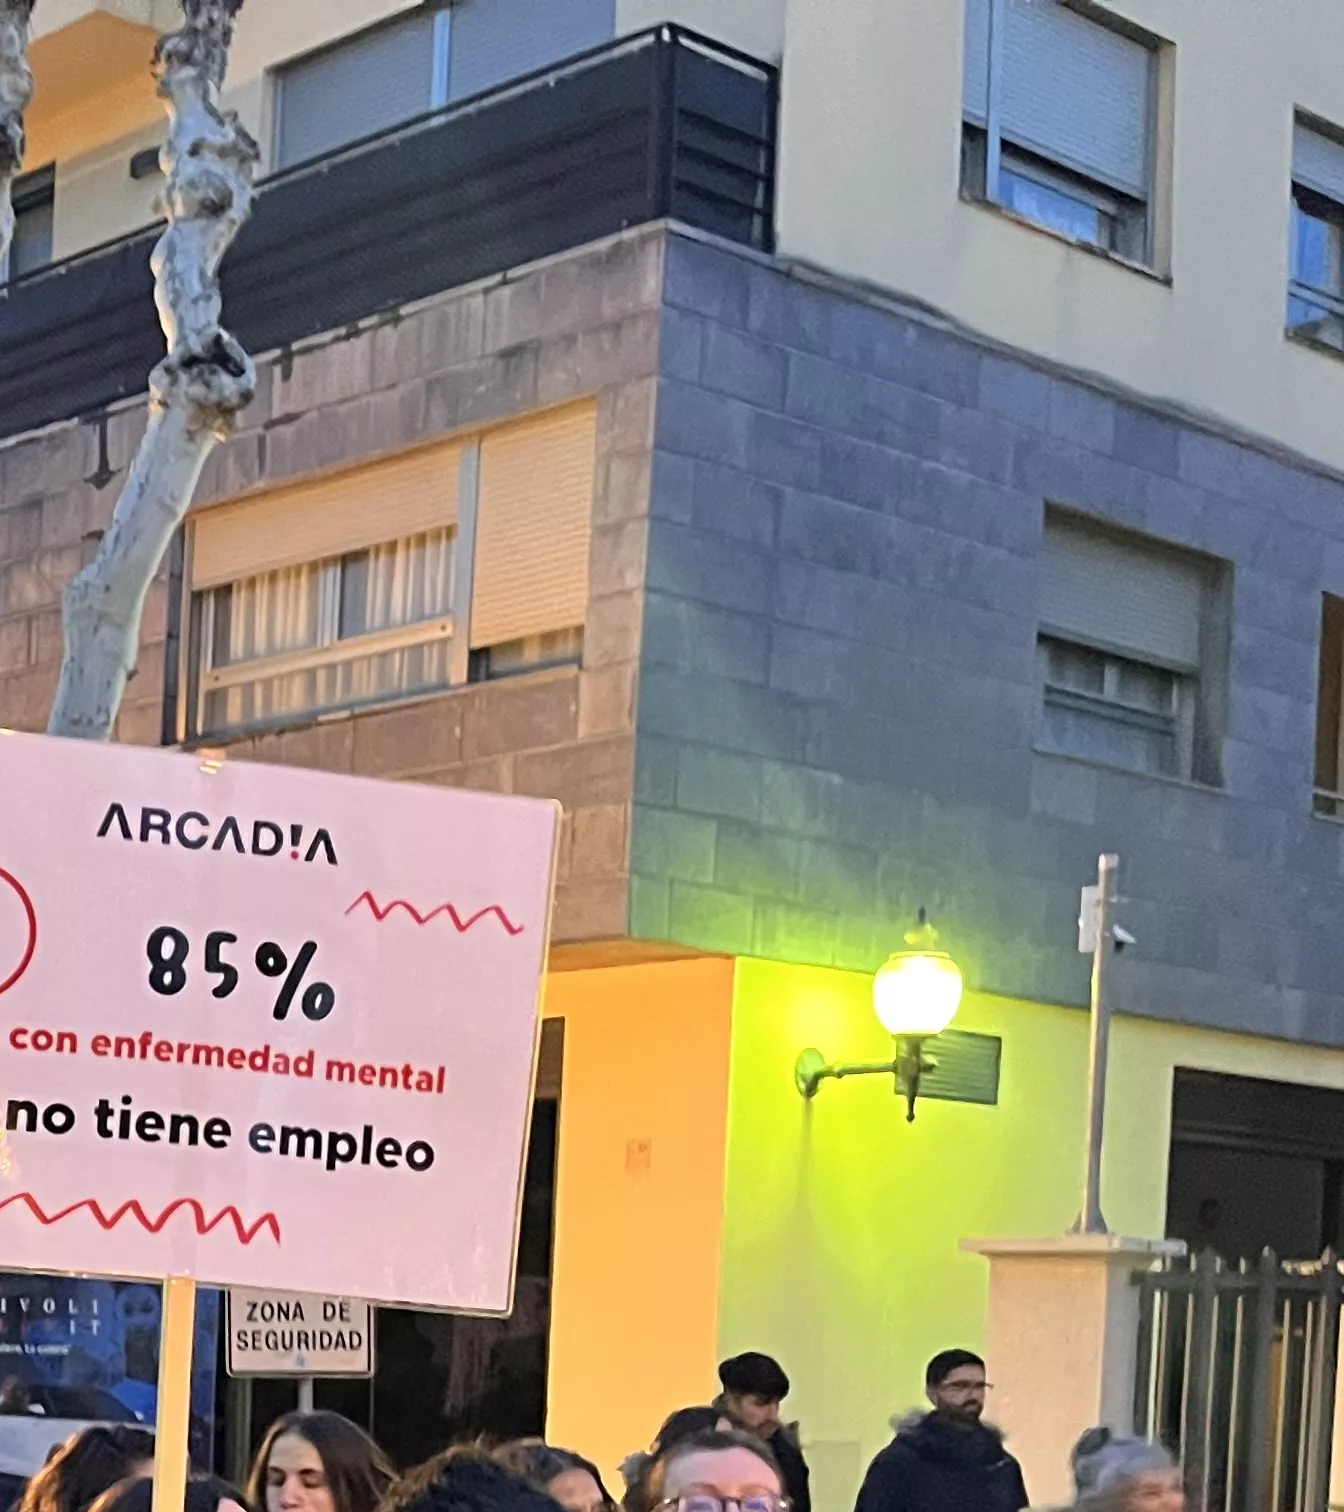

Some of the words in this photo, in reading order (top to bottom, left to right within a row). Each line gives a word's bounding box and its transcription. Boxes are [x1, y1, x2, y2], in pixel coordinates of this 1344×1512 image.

[147, 927, 334, 1020] 85%
[10, 1028, 77, 1053] con
[91, 1031, 314, 1078] enfermedad
[326, 1060, 445, 1093] mental
[6, 1100, 75, 1134] no
[94, 1095, 231, 1148] tiene
[249, 1124, 434, 1171] empleo
[237, 1330, 362, 1351] SEGURIDAD
[247, 1302, 304, 1322] ZONA
[323, 1302, 349, 1321] DE
